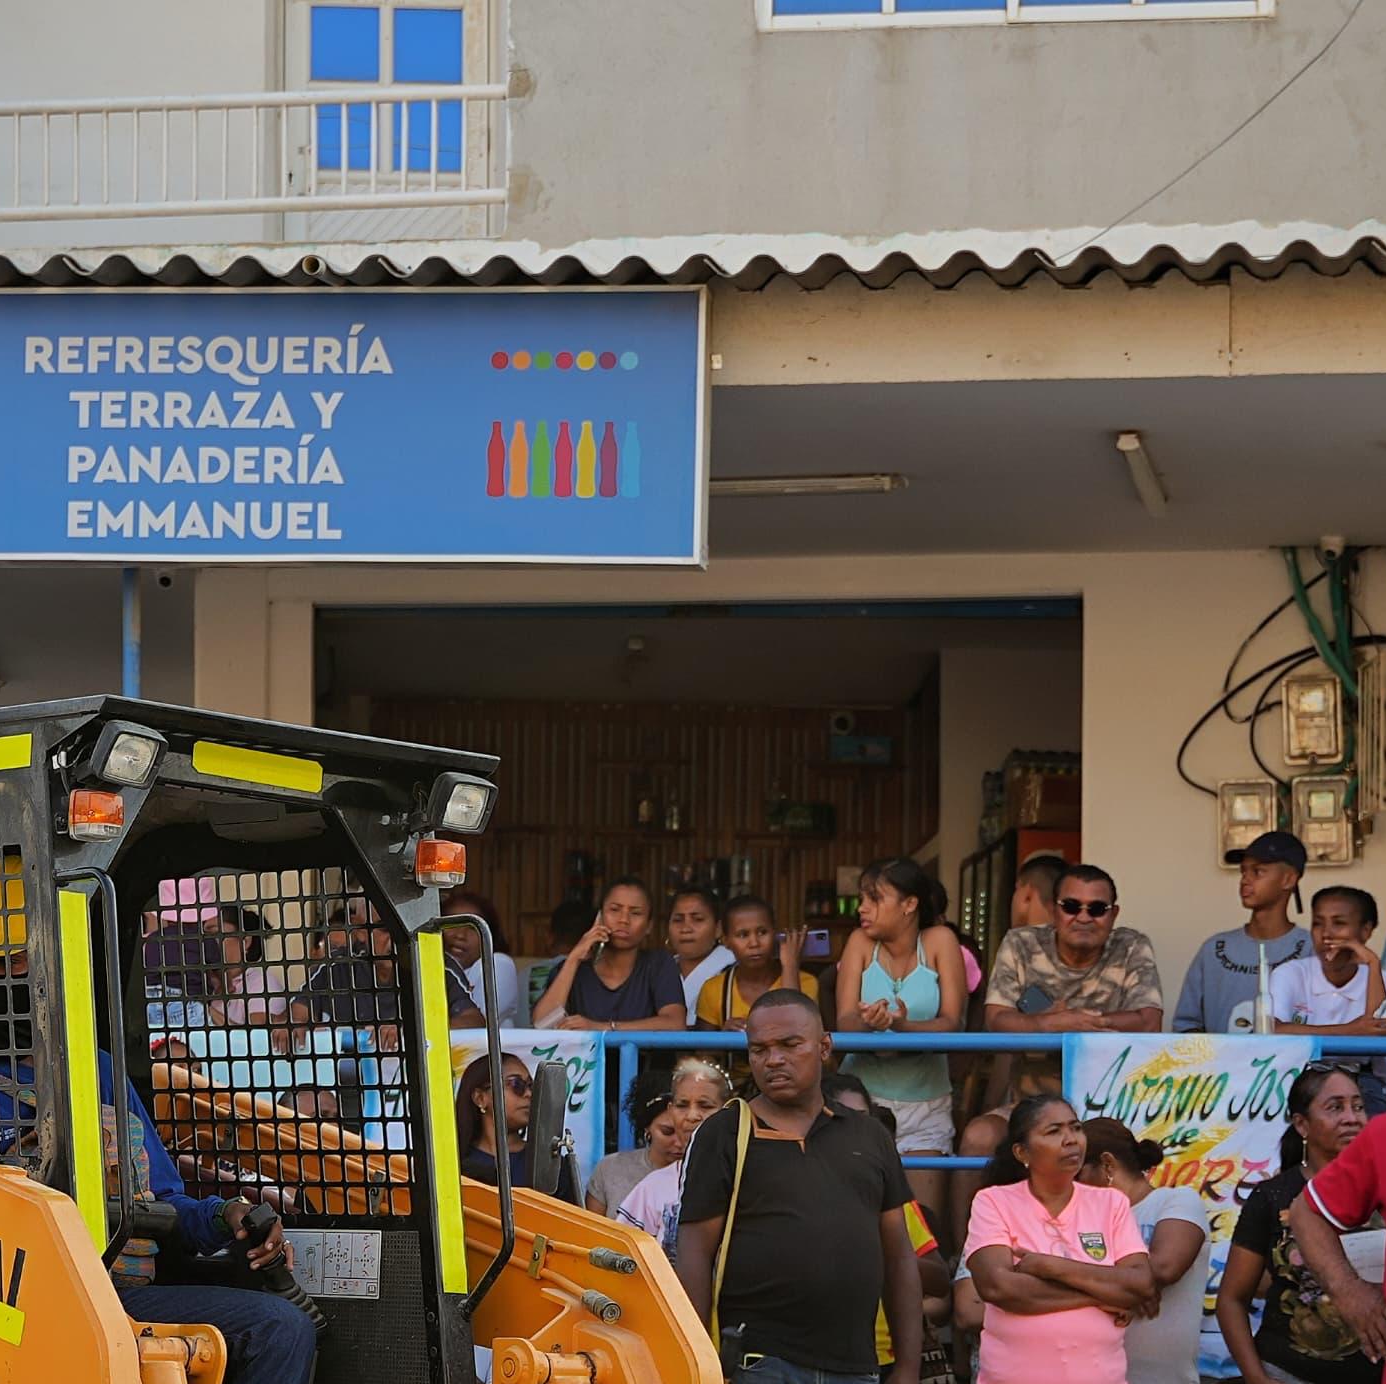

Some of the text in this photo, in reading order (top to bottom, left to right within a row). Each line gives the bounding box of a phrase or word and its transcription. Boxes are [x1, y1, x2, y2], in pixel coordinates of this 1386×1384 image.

[24, 323, 394, 386] REFRESQUERÍA
[69, 391, 345, 430] TERRAZA Y
[68, 433, 345, 485] PANADERÍA
[67, 500, 343, 540] EMMANUEL
[1226, 1054, 1305, 1123] JOS
